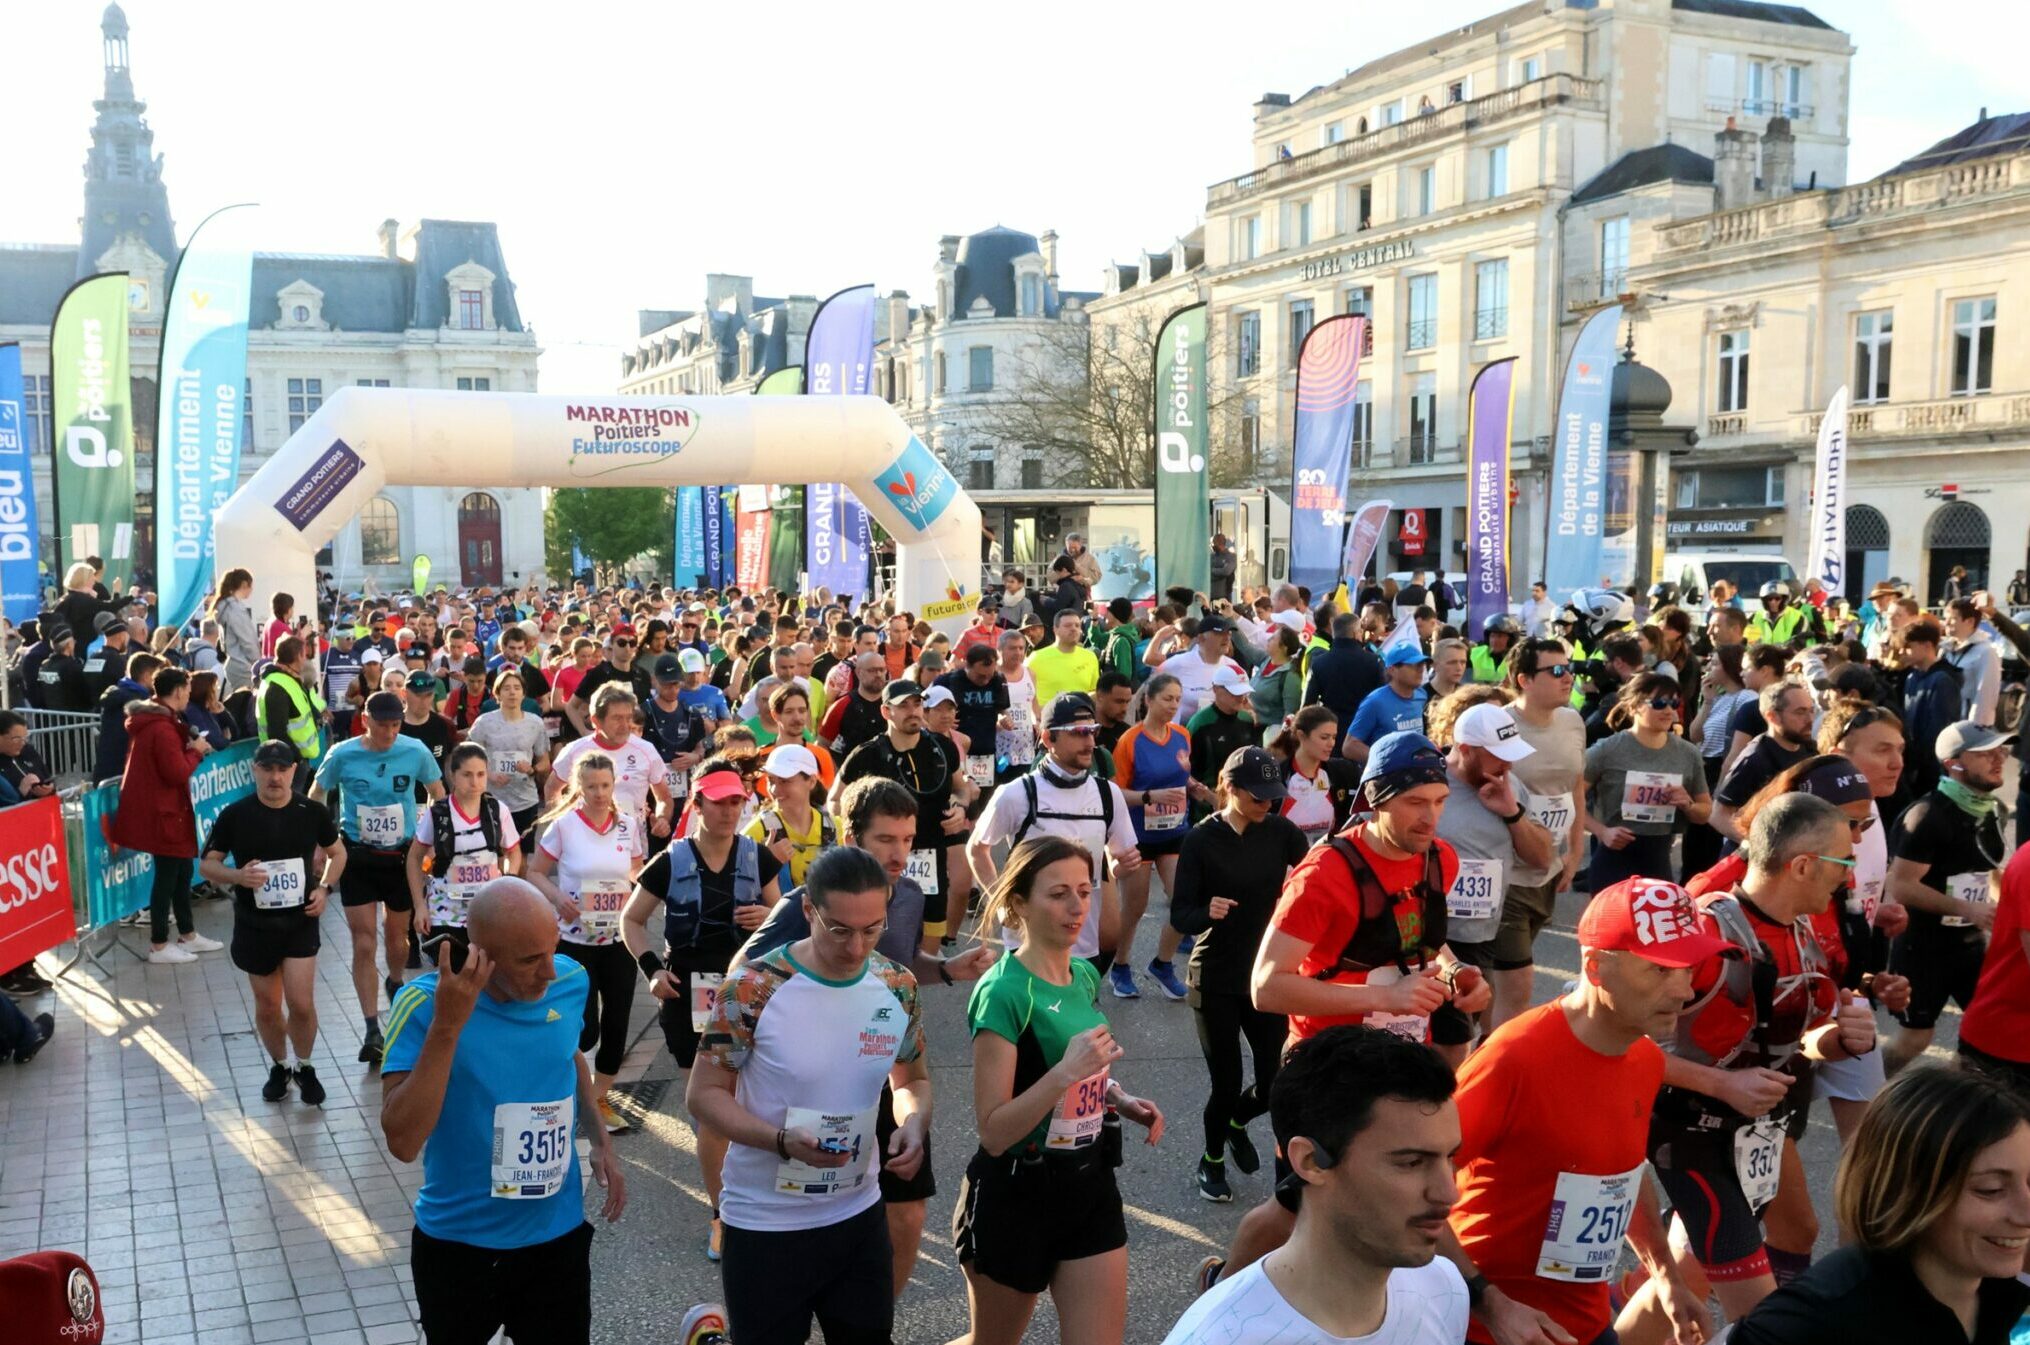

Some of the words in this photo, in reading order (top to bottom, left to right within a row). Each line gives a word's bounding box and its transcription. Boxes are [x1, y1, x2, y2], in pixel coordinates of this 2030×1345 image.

[1299, 258, 1341, 280] HOTEL
[1348, 240, 1414, 271] CENTRAL
[1172, 324, 1194, 427] poitiers
[210, 383, 236, 483] Vienne
[566, 405, 690, 427] MARATHON
[594, 424, 661, 440] Poitiers
[173, 367, 206, 560] Département
[572, 438, 681, 456] Futuroscope
[1582, 421, 1602, 487] Vienne
[286, 482, 314, 510] GRAND
[311, 450, 344, 485] POITIERS
[1298, 468, 1326, 485] 20
[1490, 462, 1499, 509] urbaine
[1558, 411, 1583, 536] Département
[1824, 430, 1841, 543] HYUNDAI
[0, 470, 32, 561] bleu
[1479, 461, 1491, 534] POITIERS
[1583, 490, 1599, 508] la
[815, 483, 832, 565] GRAND
[1404, 512, 1419, 535] Q
[1581, 512, 1598, 536] de
[1696, 521, 1747, 533] ASIATIQUE
[709, 519, 720, 571] GRAND
[1480, 536, 1494, 594] GRAND
[500, 760, 520, 773] 378
[366, 816, 397, 832] 3245
[1541, 809, 1568, 828] 3777
[101, 852, 152, 889] vienne
[264, 872, 298, 892] 3469
[458, 865, 491, 883] 3383
[1455, 876, 1492, 898] 4331
[593, 893, 624, 911] 3387
[530, 1105, 560, 1113] MARATHON
[1075, 1077, 1106, 1117] 354
[518, 1125, 567, 1164] 3515
[822, 1171, 836, 1181] LEO
[1576, 1200, 1632, 1244] 2512
